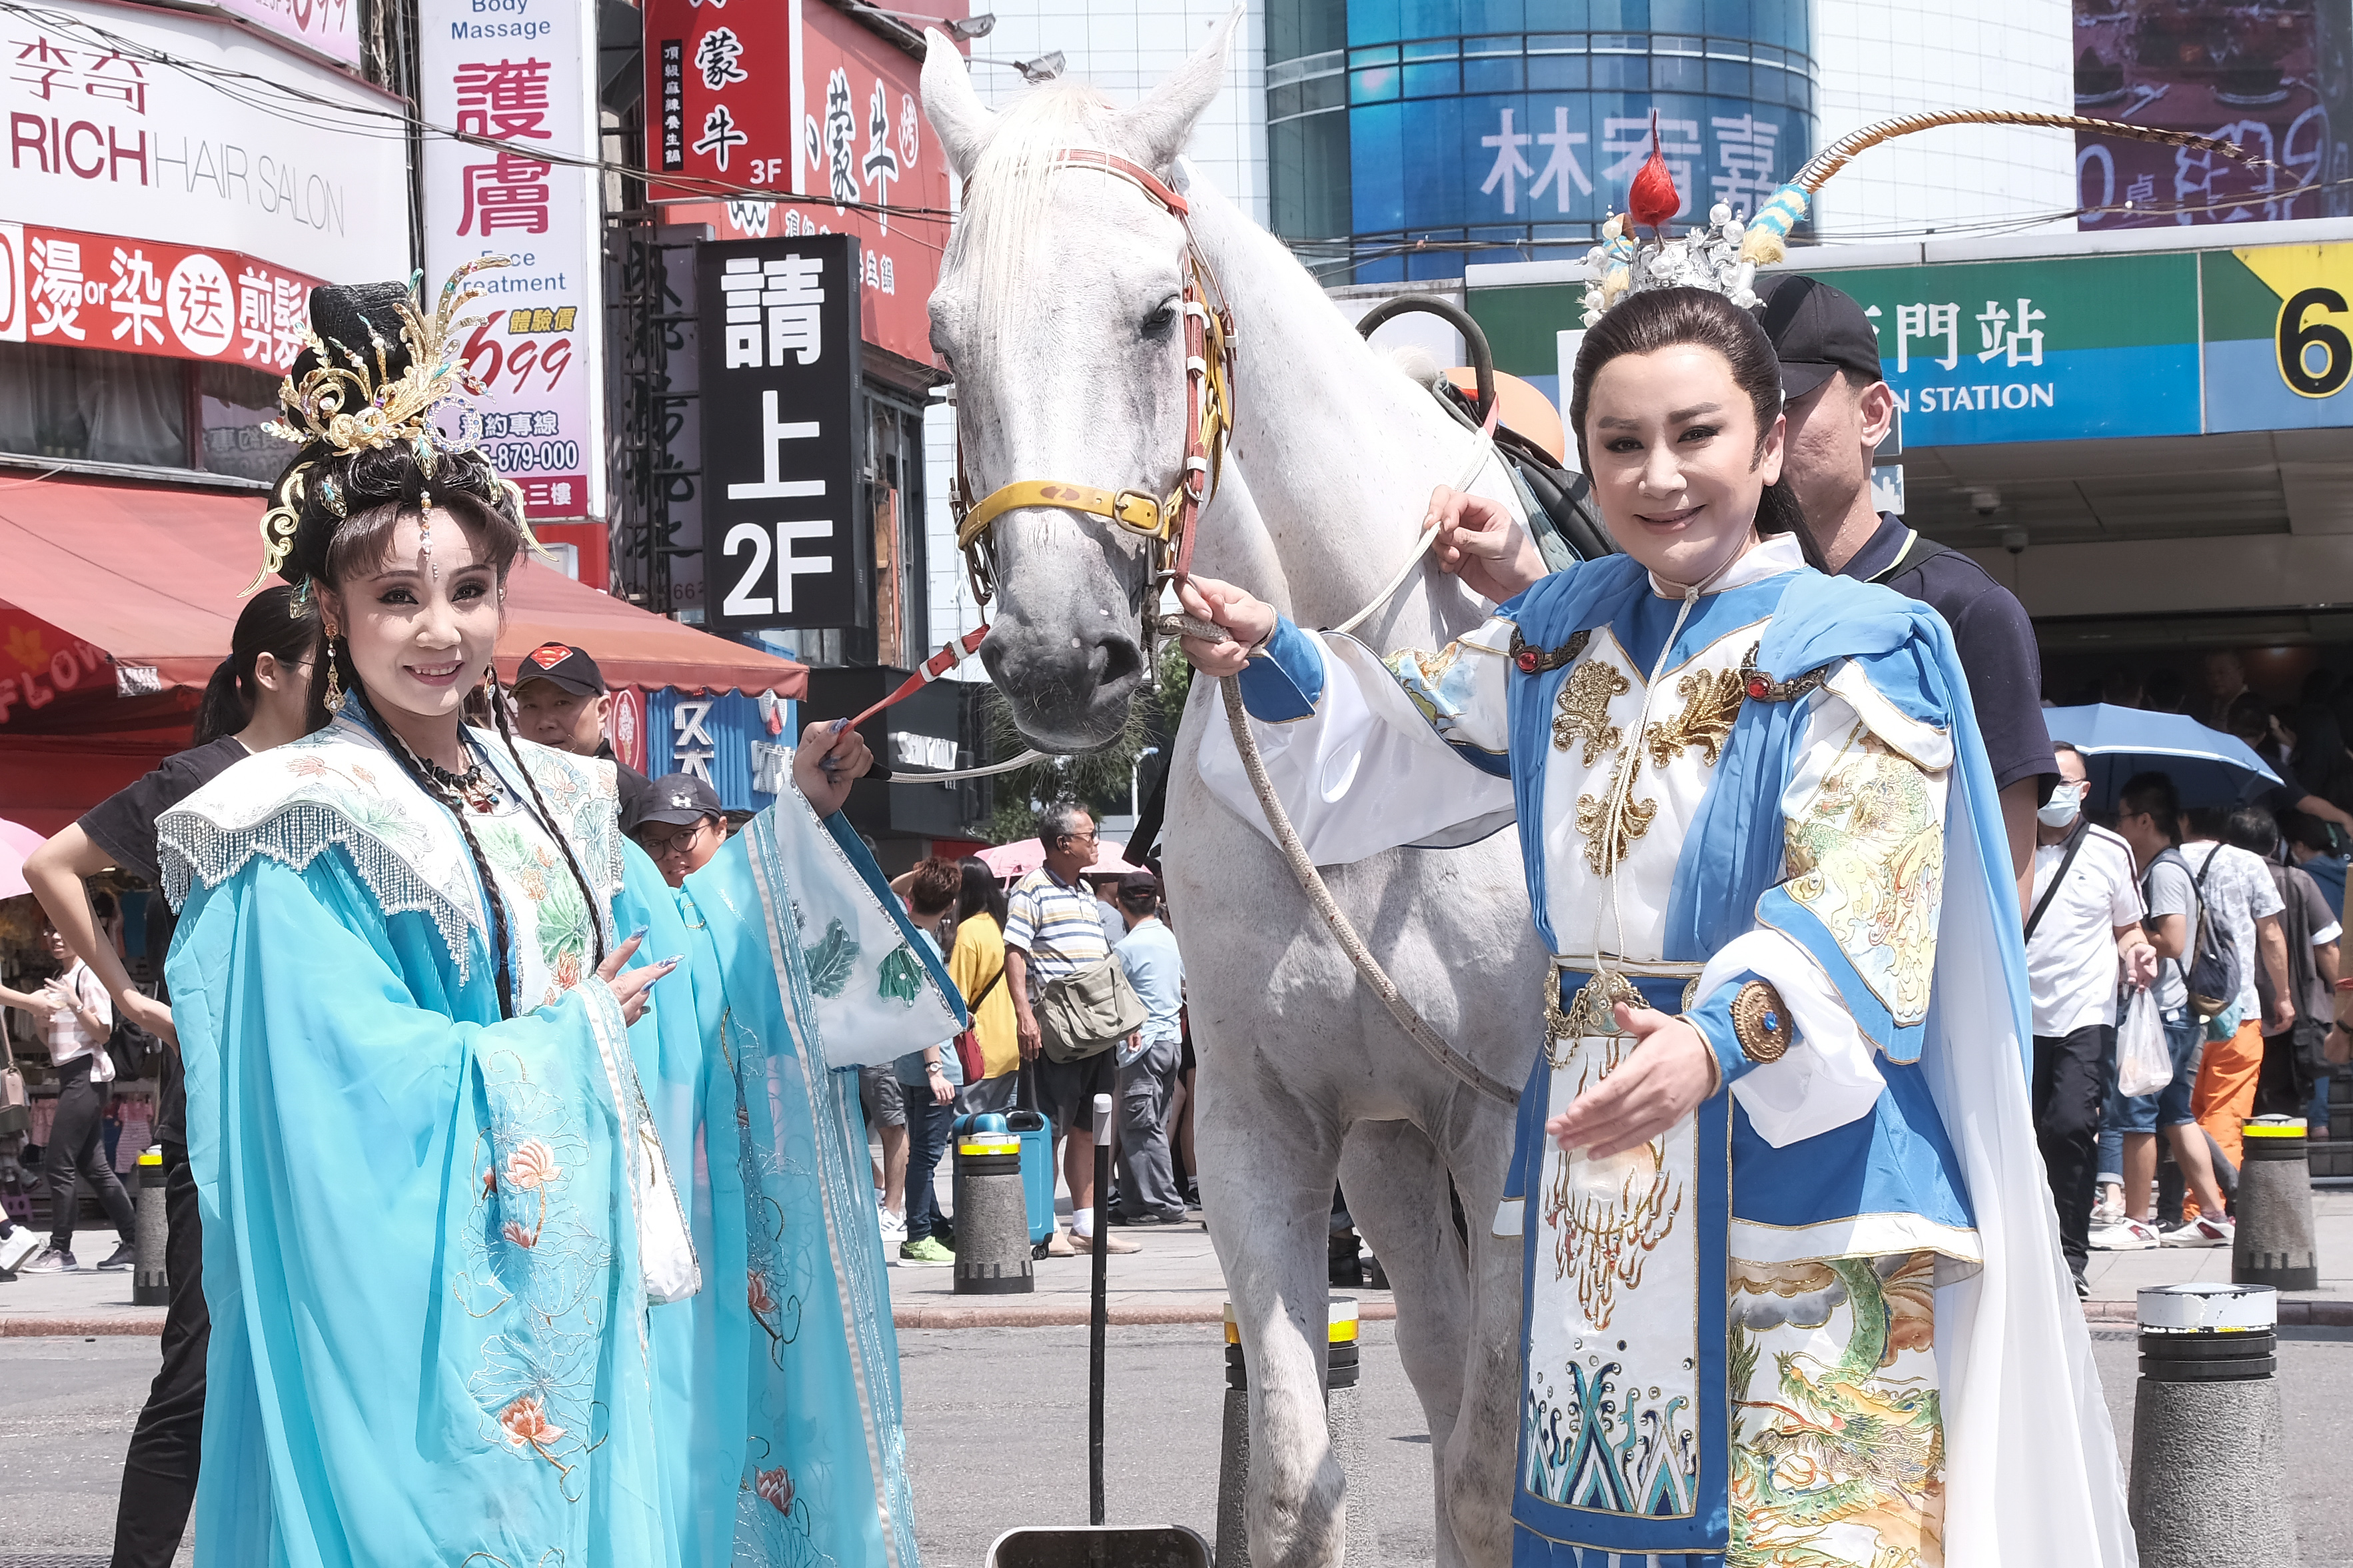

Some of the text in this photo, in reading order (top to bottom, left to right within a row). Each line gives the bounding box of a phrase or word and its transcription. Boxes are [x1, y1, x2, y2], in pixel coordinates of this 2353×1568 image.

[451, 20, 551, 40] Massage
[8, 35, 150, 116] 李奇
[692, 0, 748, 172] 蒙牛
[10, 111, 345, 238] RICH HAIR SALON
[453, 57, 552, 237] 護膚
[750, 159, 782, 185] 3F
[462, 273, 566, 293] reatment
[508, 306, 577, 335] 體驗價
[460, 310, 572, 396] 699
[1865, 297, 2047, 374] 門站
[2279, 287, 2353, 398] 6
[460, 411, 558, 438] 約專線
[1920, 382, 2054, 413] STATION
[522, 482, 572, 505] 三樓
[723, 520, 834, 616] 2F
